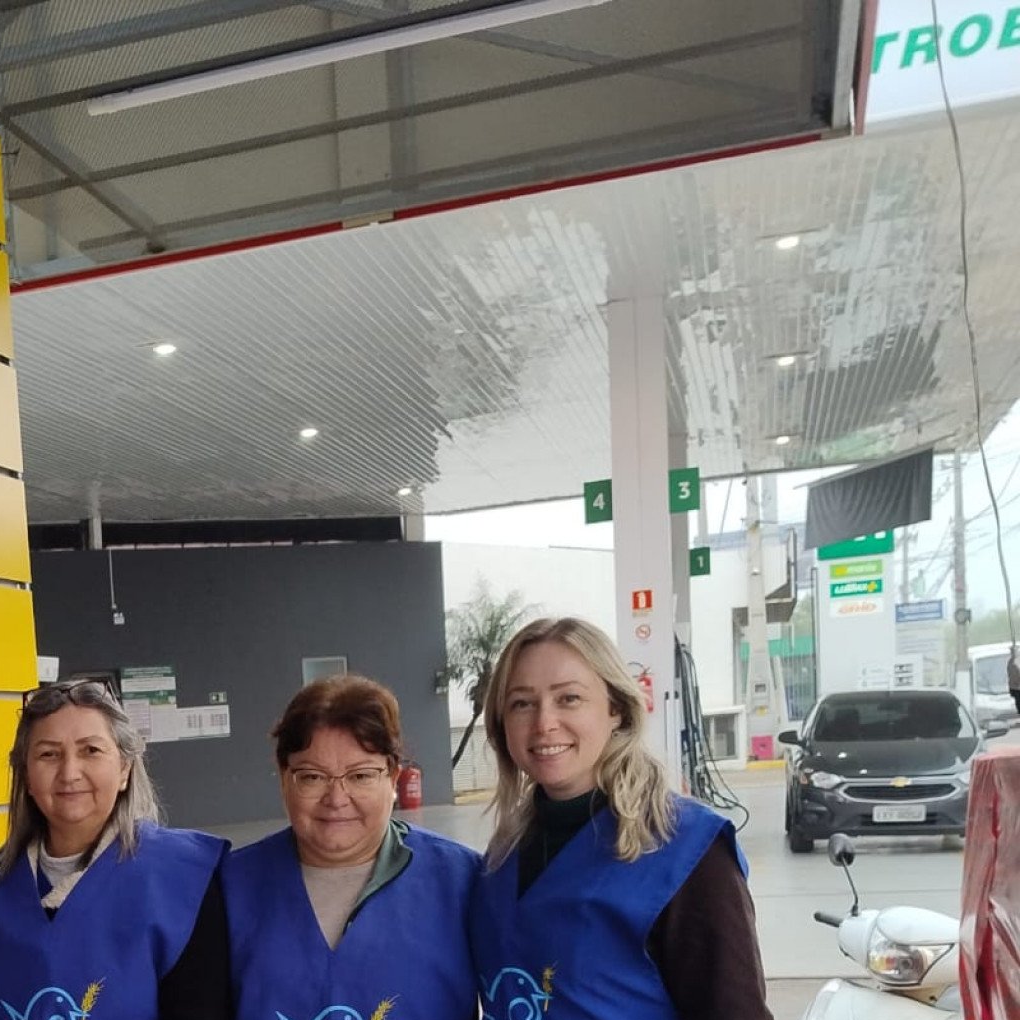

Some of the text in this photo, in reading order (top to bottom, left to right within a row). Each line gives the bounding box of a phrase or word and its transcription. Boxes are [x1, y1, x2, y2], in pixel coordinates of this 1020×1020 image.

[678, 481, 690, 500] 3
[592, 492, 605, 511] 4
[696, 556, 704, 568] 1
